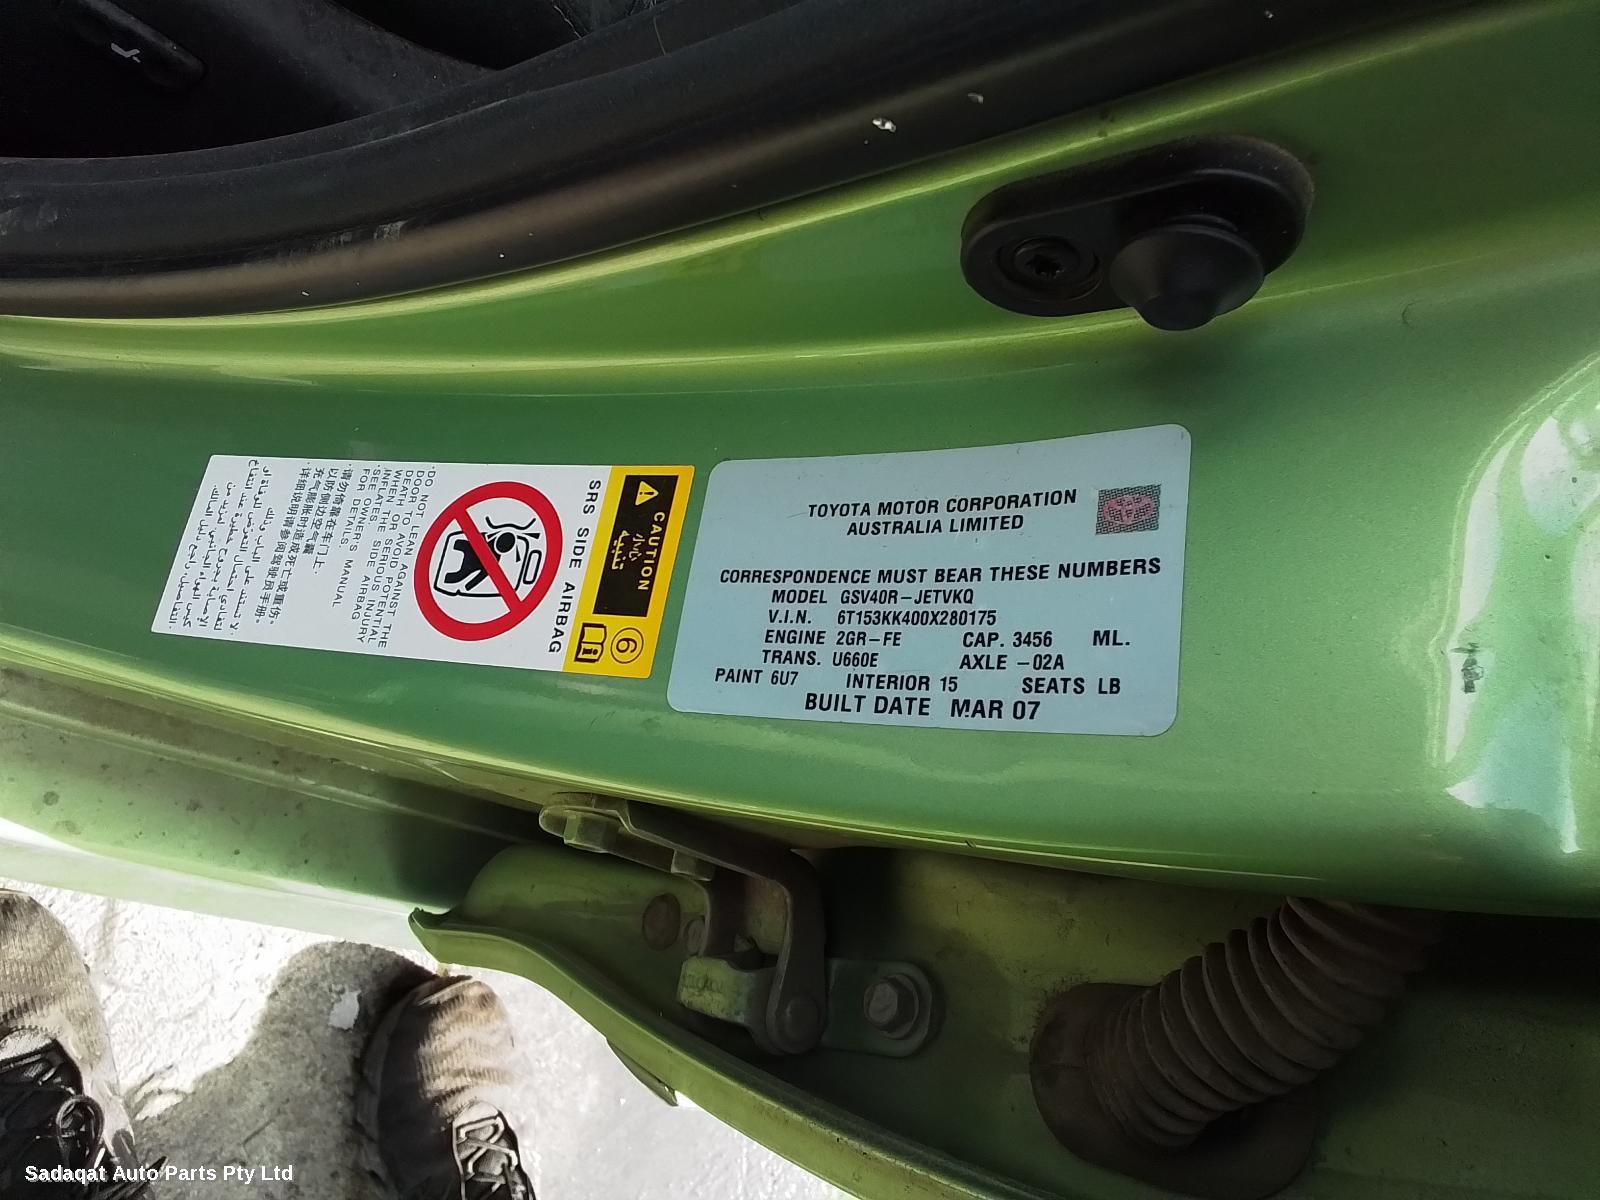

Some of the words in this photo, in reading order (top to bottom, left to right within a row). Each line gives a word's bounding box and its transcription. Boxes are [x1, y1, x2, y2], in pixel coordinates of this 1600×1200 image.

[356, 469, 370, 490] FOR
[367, 469, 380, 490] SEE
[385, 469, 402, 502] WHEN
[395, 470, 413, 506] DEATH
[407, 470, 424, 502] DOOR
[423, 470, 435, 486] DO
[367, 469, 391, 524] INFLATES.
[414, 494, 428, 517] NOT
[582, 480, 601, 514] SRS
[808, 503, 870, 518] TOYOTA
[878, 500, 939, 516] MOTOR
[946, 489, 1076, 514] CORPORATION
[338, 498, 360, 548] DETAILS.
[348, 498, 371, 551] OWNER'S
[376, 510, 390, 531] THE
[388, 514, 400, 530] OR
[401, 511, 412, 525] TO
[847, 520, 942, 536] AUSTRALIA
[950, 515, 1024, 533] LIMITED
[366, 540, 381, 567] SIDE
[388, 533, 406, 568] AVOID
[403, 526, 419, 555] LEAN
[568, 527, 589, 568] SIDE
[607, 529, 631, 570] تنبيه
[627, 533, 646, 561] 小心
[636, 511, 665, 590] CAUTION
[370, 538, 393, 591] SERIOUS
[720, 569, 870, 584] CORRESPONDENCE
[877, 568, 927, 584] MUST
[935, 567, 980, 583] BEAR
[988, 564, 1049, 582] THESE
[1057, 558, 1161, 579] NUMBERS
[331, 559, 353, 607] MANUAL
[350, 575, 371, 619] AIRBAG
[386, 563, 408, 615] AGAINST
[772, 589, 827, 604] MODEL
[355, 599, 375, 642] INJURY
[366, 576, 393, 643] POTENTIAL
[548, 581, 576, 653] AIRBAG
[768, 610, 812, 624] V.I.N.
[837, 610, 997, 626] 6T153KK400X280175
[377, 624, 391, 648] THE
[765, 630, 825, 645] ENGINE
[836, 631, 901, 646] 2GR-FE
[963, 632, 1004, 647] CAP.
[1013, 631, 1053, 647] 3456
[1093, 630, 1130, 646] ML.
[762, 650, 820, 666] TRANS.
[833, 652, 878, 668] U660E
[959, 654, 1006, 669] AXLE
[715, 668, 761, 684] PAINT
[771, 671, 799, 686] 6U7
[846, 673, 930, 691] INTERIOR
[940, 676, 958, 692] 15
[1021, 677, 1084, 695] SEATS
[1098, 678, 1121, 695] LB
[805, 693, 868, 714] BUILT
[874, 697, 930, 716] DATE
[950, 701, 1004, 719] MAR
[1013, 701, 1041, 720] 07
